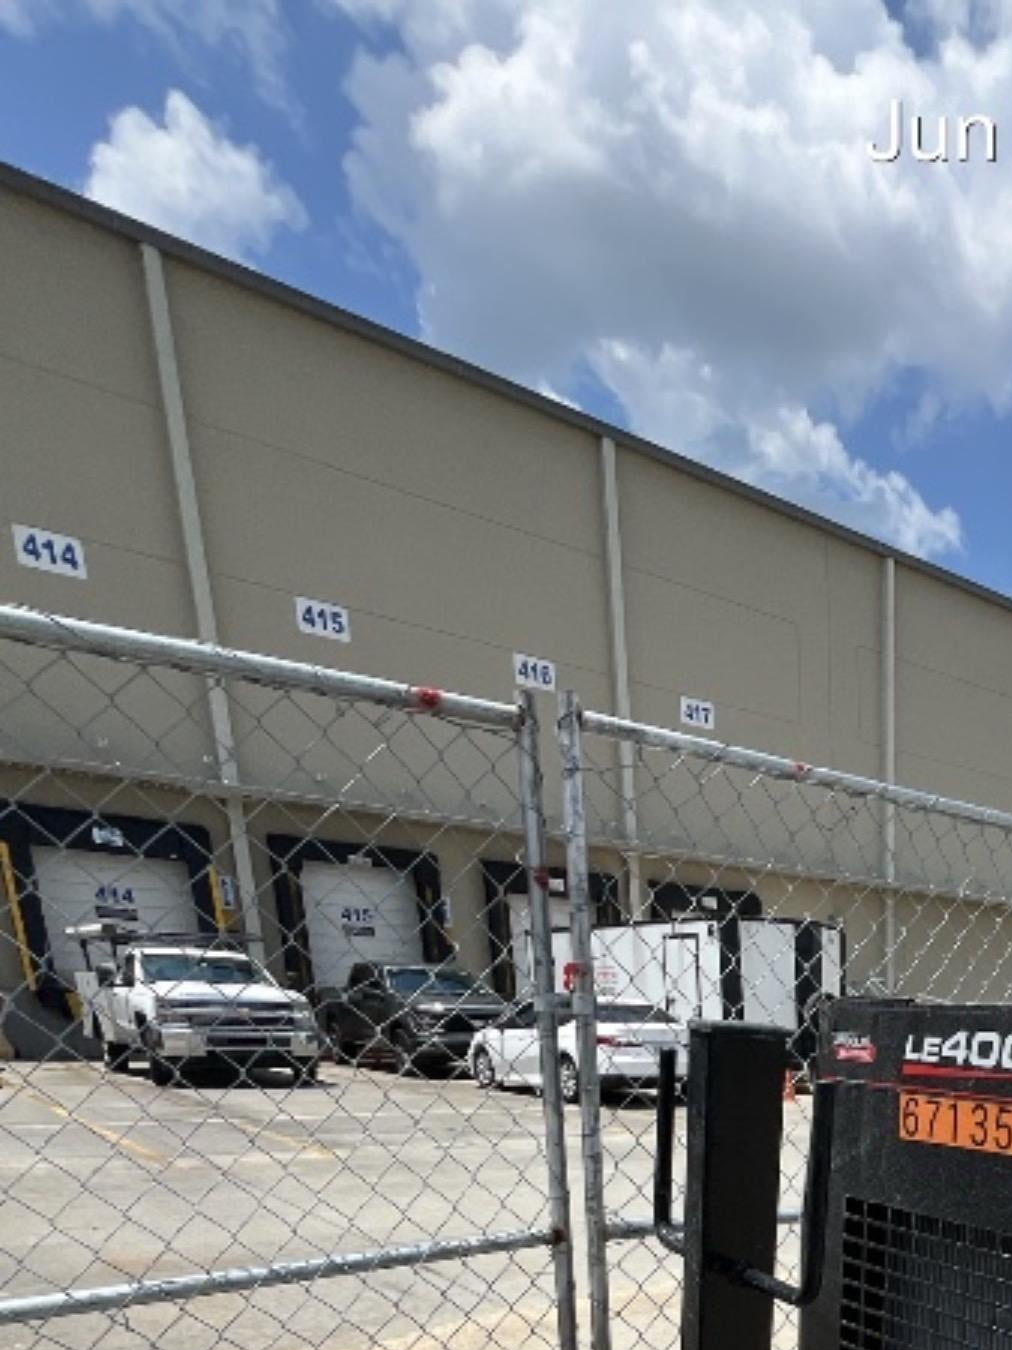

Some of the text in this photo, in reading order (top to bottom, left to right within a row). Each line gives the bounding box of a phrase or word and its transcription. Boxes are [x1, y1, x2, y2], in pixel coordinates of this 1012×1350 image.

[22, 532, 79, 572] 414
[302, 604, 345, 635] 415
[518, 660, 553, 686] 416
[684, 703, 712, 724] 417
[95, 885, 135, 904] 414
